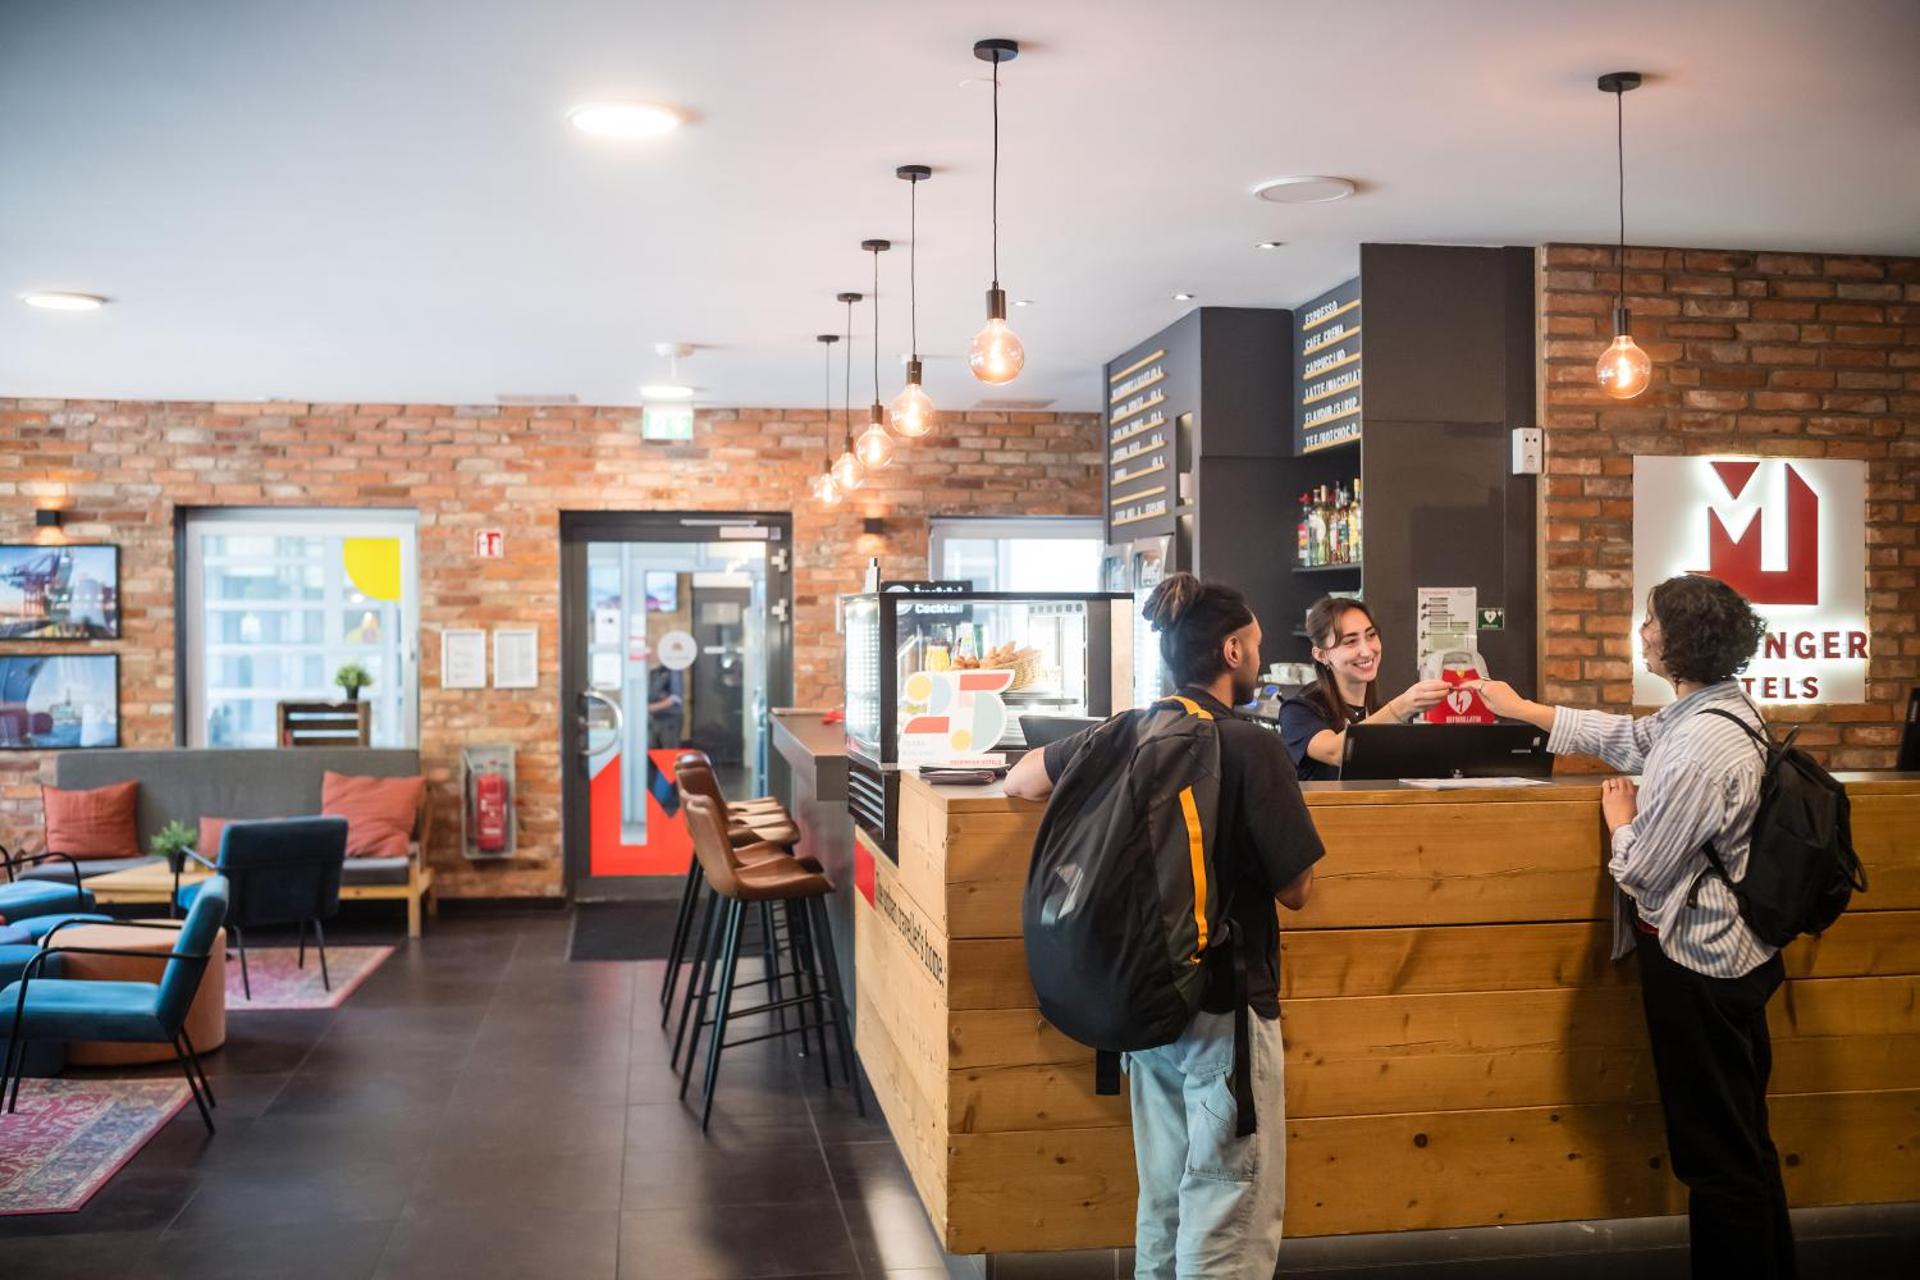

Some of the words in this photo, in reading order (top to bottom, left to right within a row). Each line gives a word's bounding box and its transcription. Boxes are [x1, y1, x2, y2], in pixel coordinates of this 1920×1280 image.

[1305, 301, 1338, 324] ESPRESSO
[1764, 631, 1868, 659] NGER
[1740, 677, 1819, 699] TELS
